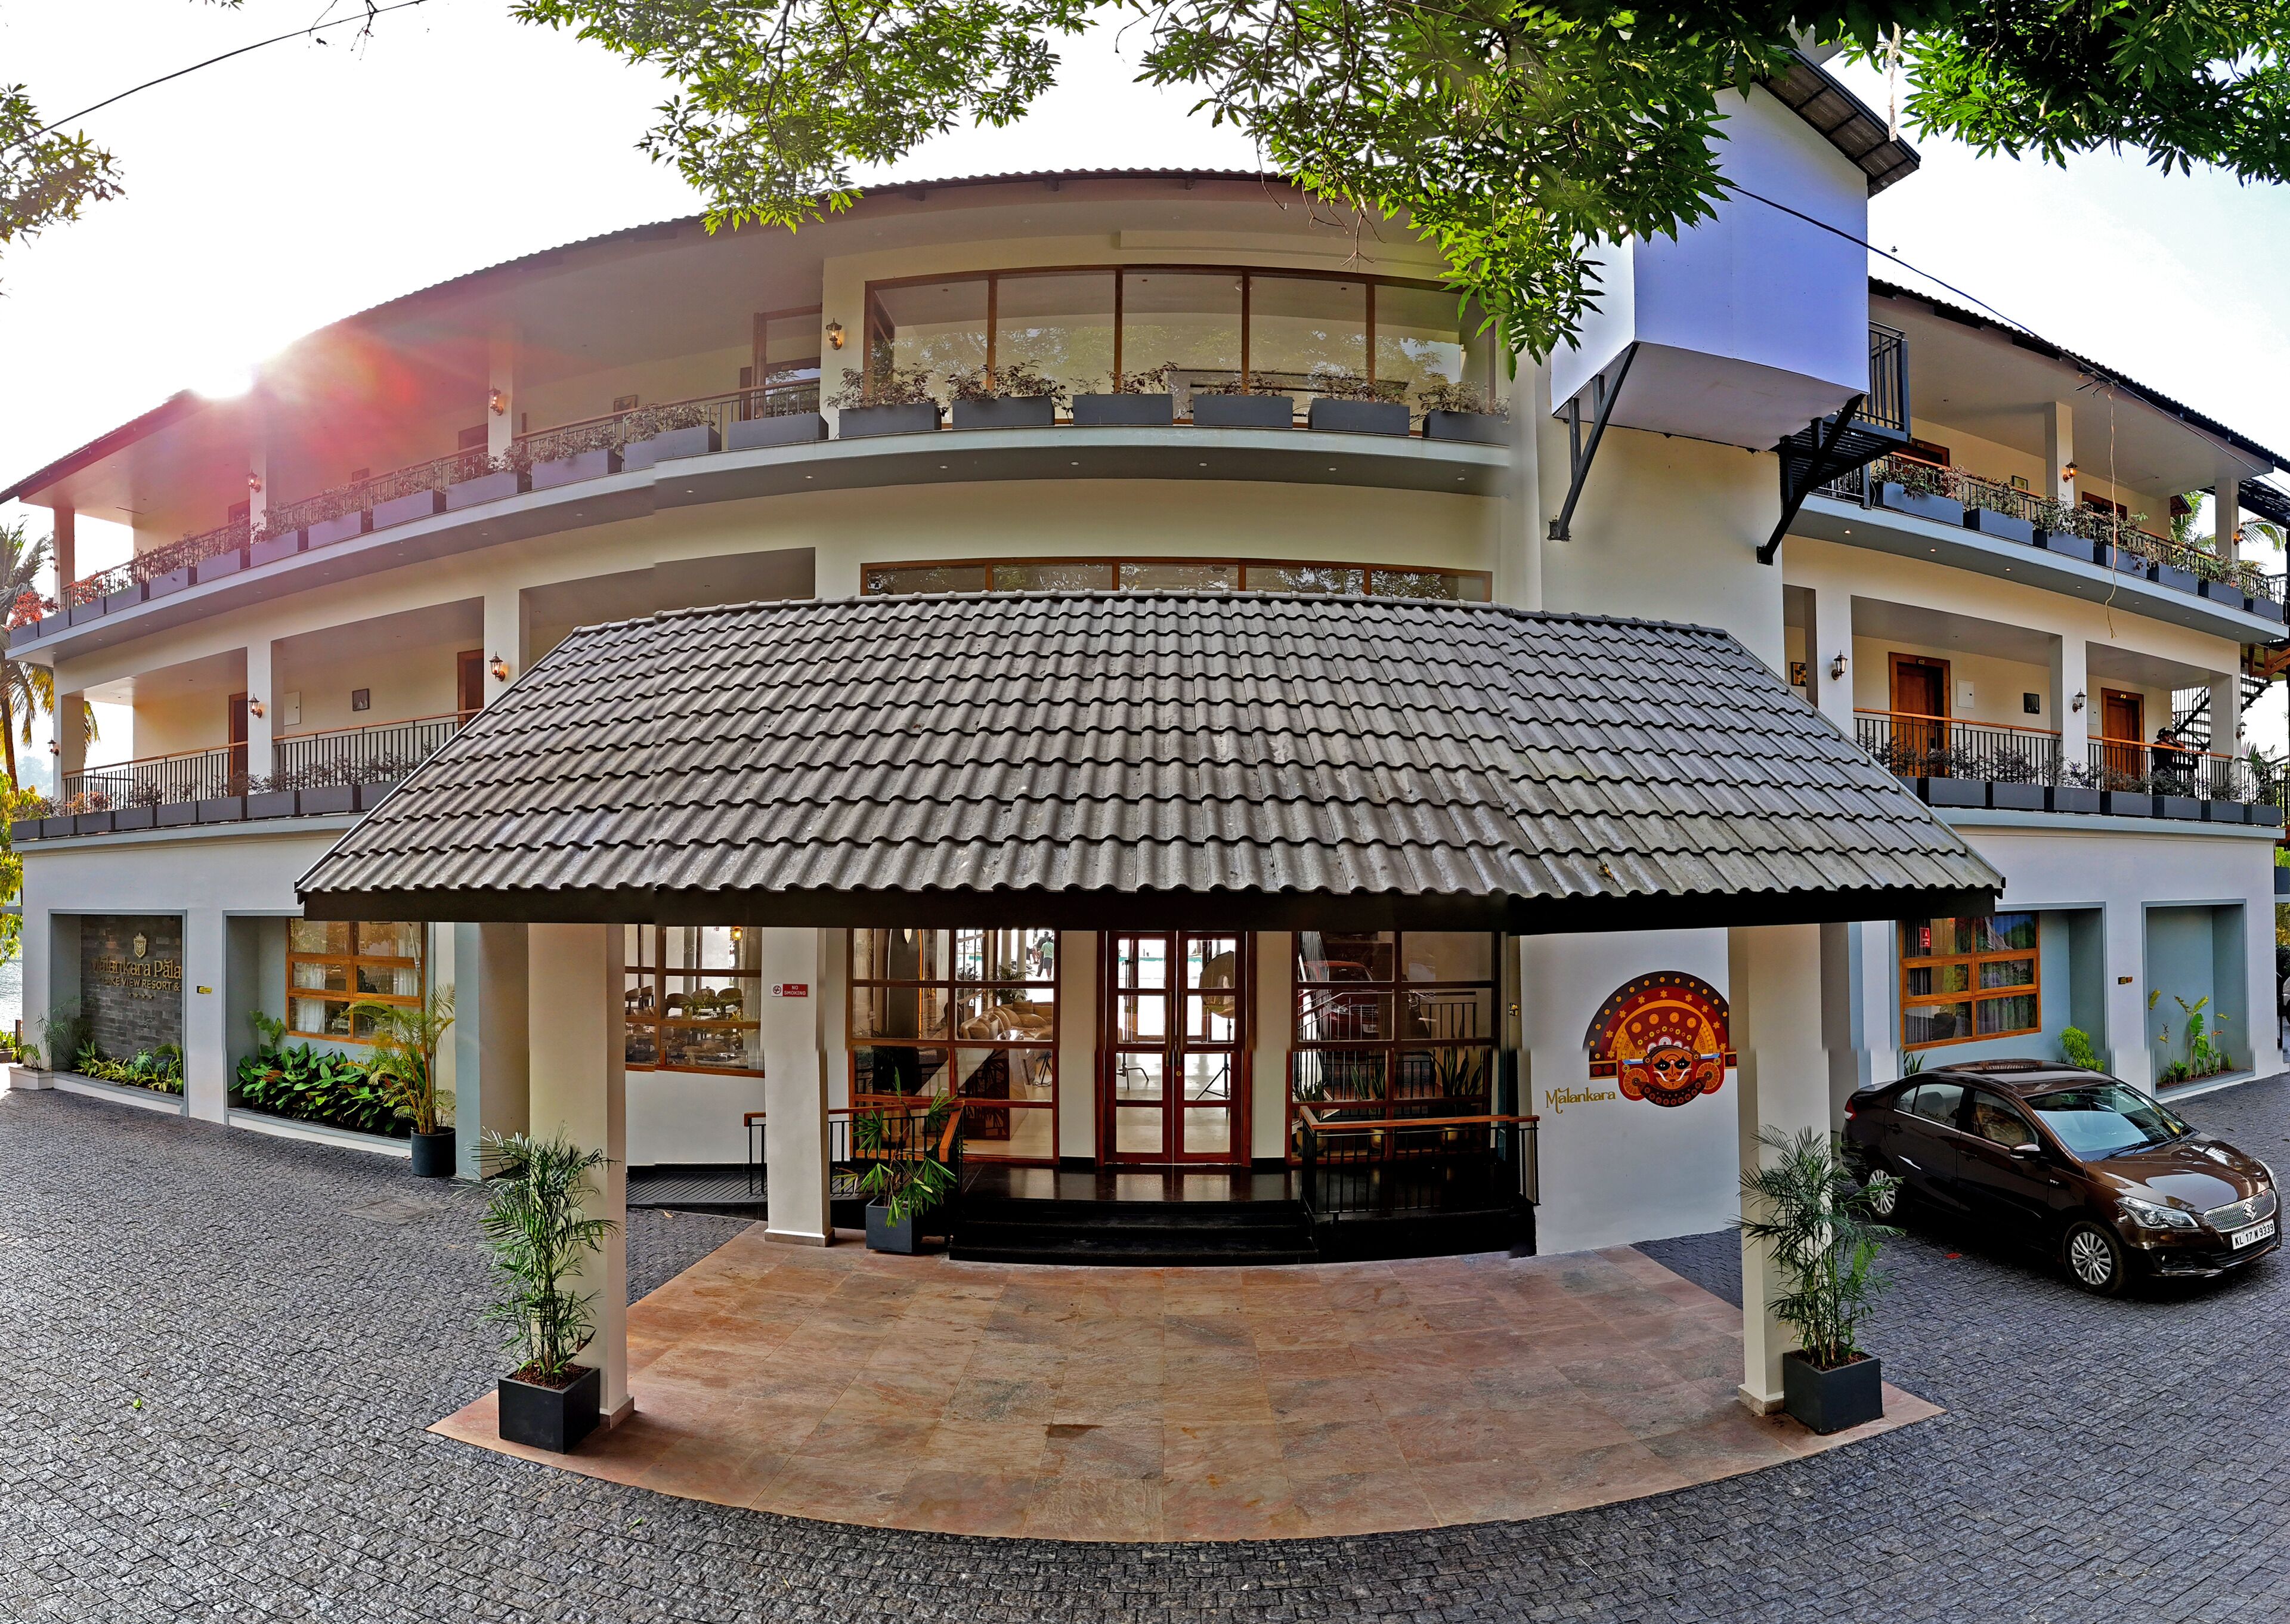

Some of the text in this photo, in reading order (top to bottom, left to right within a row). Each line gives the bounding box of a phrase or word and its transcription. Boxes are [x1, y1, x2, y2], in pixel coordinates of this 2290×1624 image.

[154, 958, 183, 979] Pala
[121, 978, 141, 988] VIEW
[141, 979, 172, 991] RESORT
[174, 982, 181, 991] &
[1545, 1087, 1616, 1114] Malankara
[2235, 1236, 2243, 1246] KL
[2245, 1231, 2252, 1242] 17
[2259, 1223, 2273, 1236] 9339
